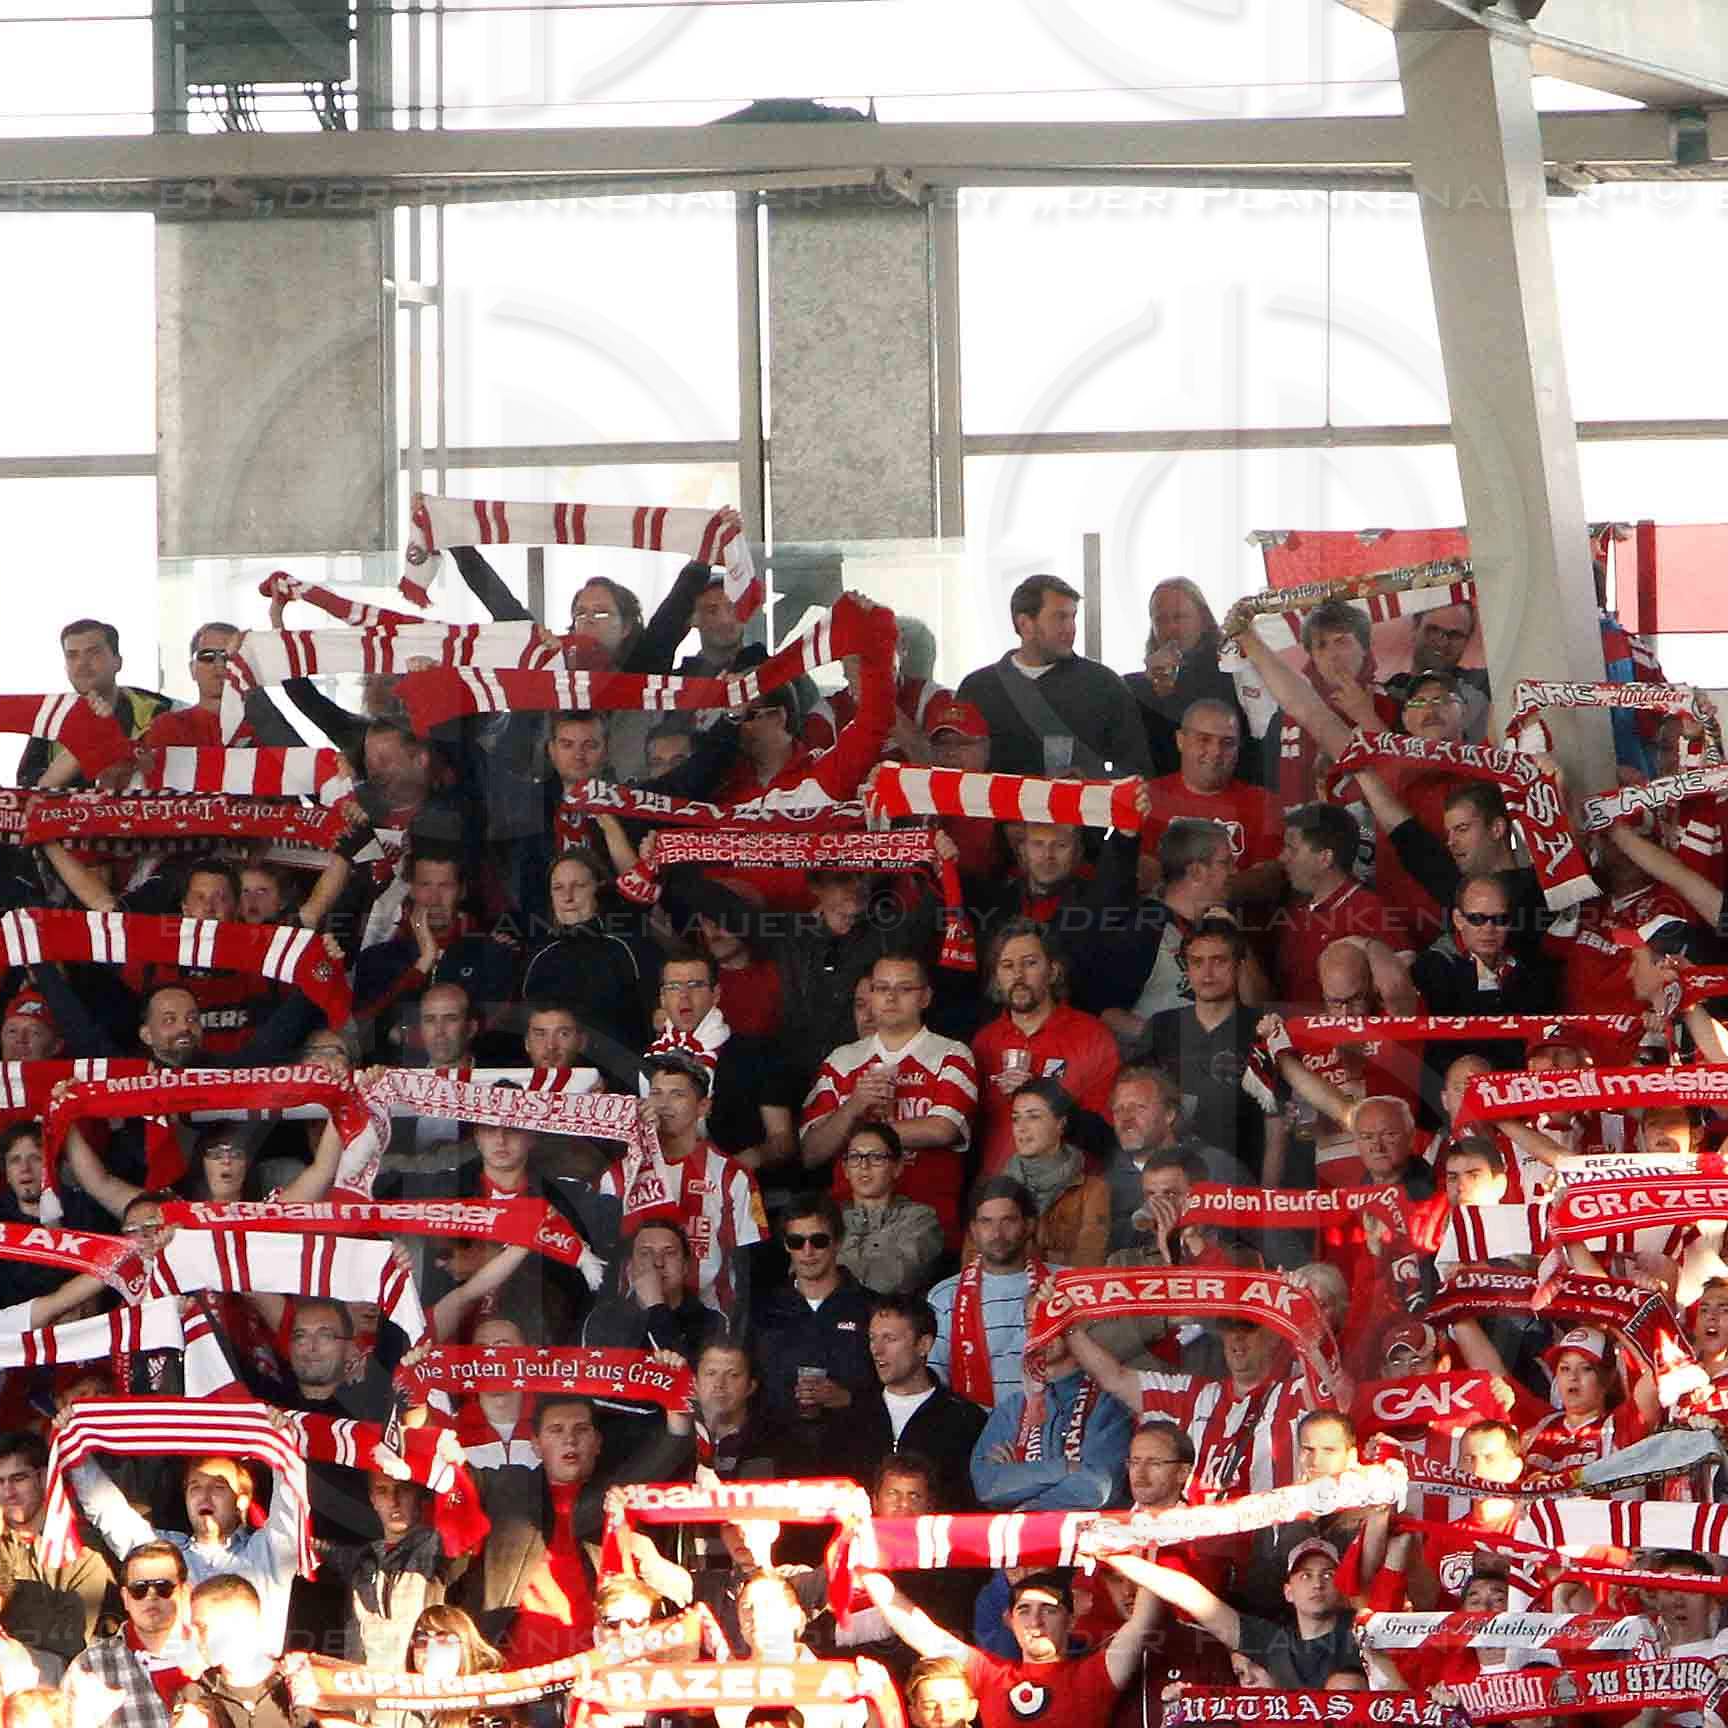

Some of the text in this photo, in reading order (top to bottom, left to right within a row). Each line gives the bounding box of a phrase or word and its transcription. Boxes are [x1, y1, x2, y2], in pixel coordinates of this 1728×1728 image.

[1479, 1076, 1600, 1110] fußball
[340, 1202, 505, 1227] meister
[1203, 1186, 1338, 1213] roten Teufel
[20, 1222, 96, 1257] AK
[1045, 1277, 1296, 1317] GRAZER AK
[449, 1357, 673, 1393] roten Teufel aus Graz
[1371, 1379, 1484, 1422] GAK
[1379, 1615, 1448, 1638] Grazer
[1586, 1657, 1719, 1698] GRAZER AK
[1178, 1695, 1355, 1724] ULTRAS
